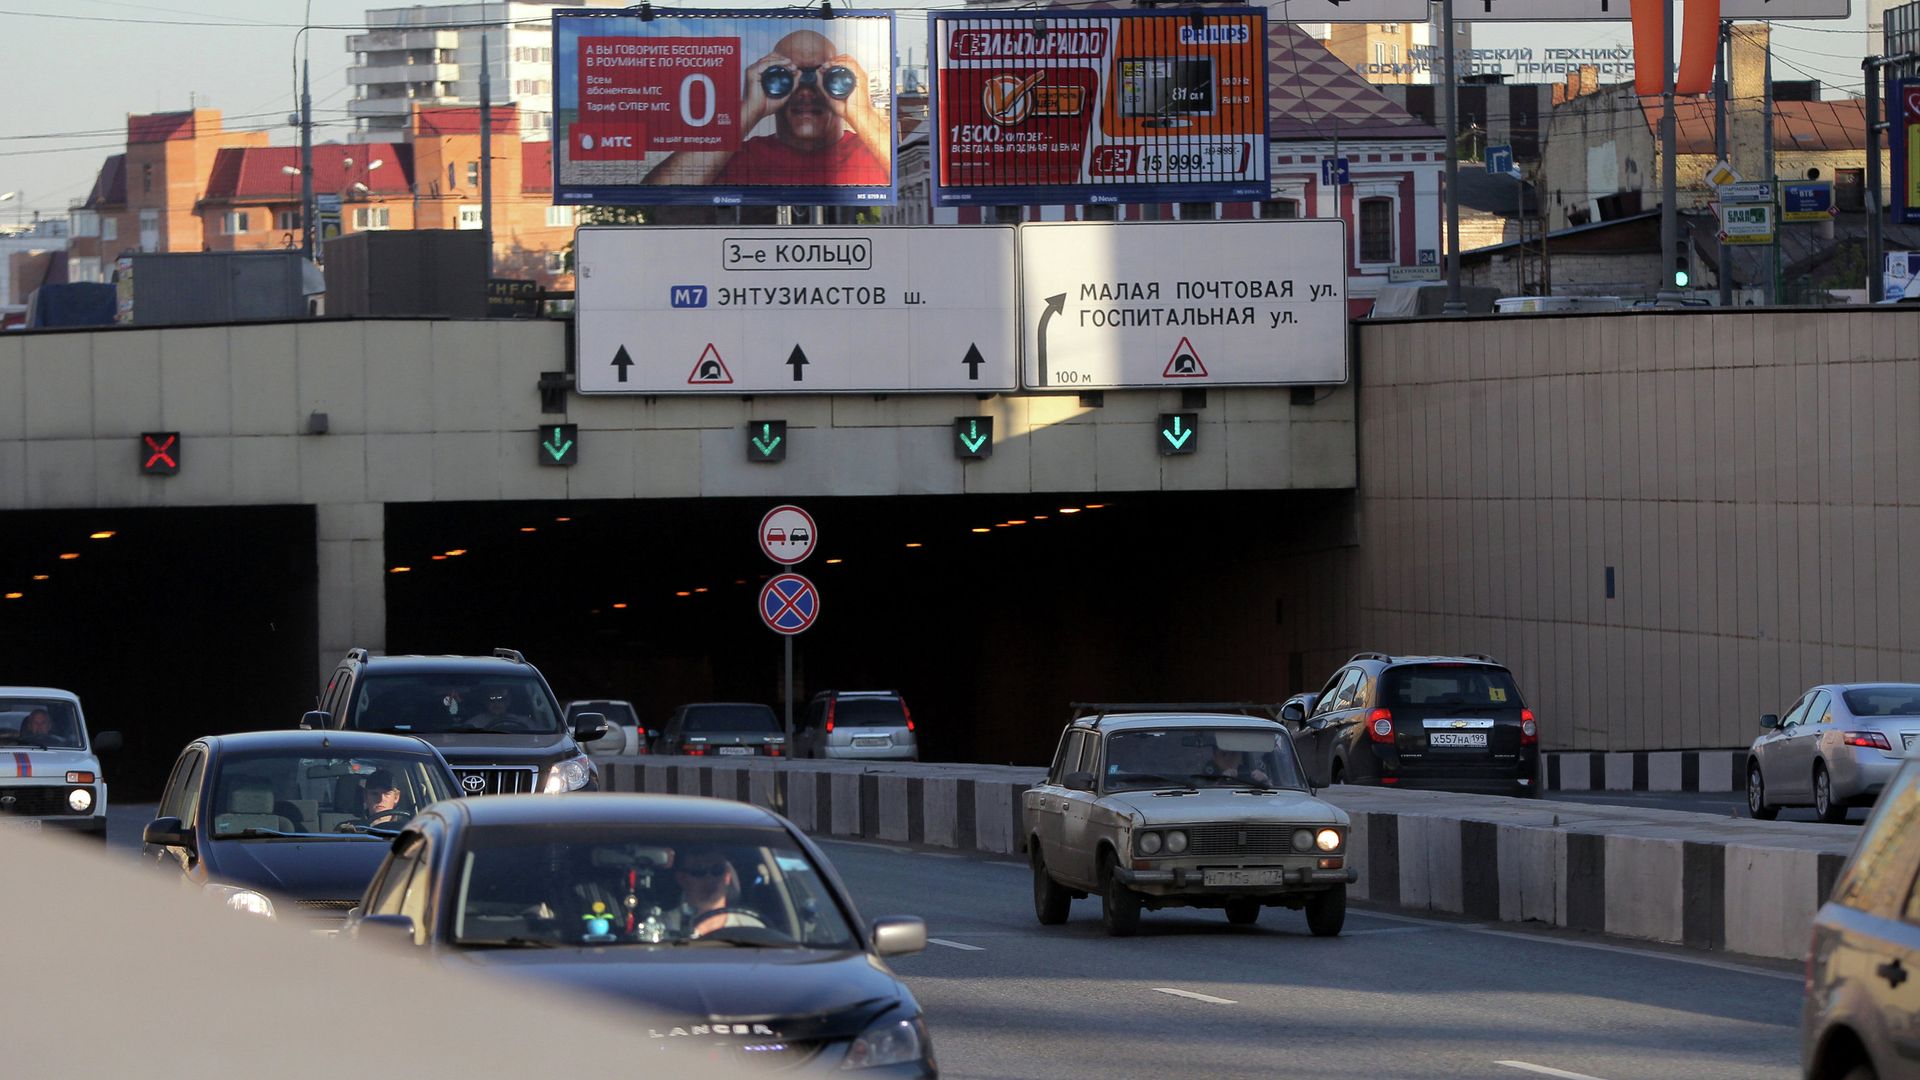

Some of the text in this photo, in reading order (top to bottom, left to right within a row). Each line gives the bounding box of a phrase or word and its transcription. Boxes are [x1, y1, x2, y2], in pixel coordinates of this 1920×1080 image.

[1182, 28, 1248, 40] PHILIPS
[586, 44, 734, 55] А ВЫ ГОВОРИТЕ БЕСПЛАТНО
[1545, 48, 1635, 60] ТЕХНИКУ
[586, 57, 724, 67] В РОУМИНГЕ ПО РОССИИ?
[1356, 62, 1502, 75] КОСМИЧЕКОГО
[586, 75, 612, 84] Всем
[586, 86, 663, 95] абонентам МТС
[1172, 87, 1187, 100] 81
[680, 73, 716, 127] 0
[587, 102, 671, 112] Тариф СУПЕР МТС
[951, 125, 1000, 142] 1500
[601, 136, 633, 147] МТС
[683, 136, 722, 144] впереди
[951, 144, 991, 153] ВСЕГДА
[993, 144, 1048, 153] ВЫГОДНАЯ
[1142, 154, 1163, 172] 15
[776, 244, 866, 265] КОЛЬЦО
[1422, 252, 1434, 263] 24
[674, 287, 927, 305] М7 ЭНТУЗИАСТОВ ш.
[1080, 280, 1337, 302] МАЛАЯ ПОЧТОВАЯ ул.
[1080, 307, 1298, 329] ГОСПИТАЛЬНАЯ ул.
[1055, 371, 1092, 383] 100 м
[1472, 734, 1485, 742] 199
[648, 1024, 774, 1038] LANCER
